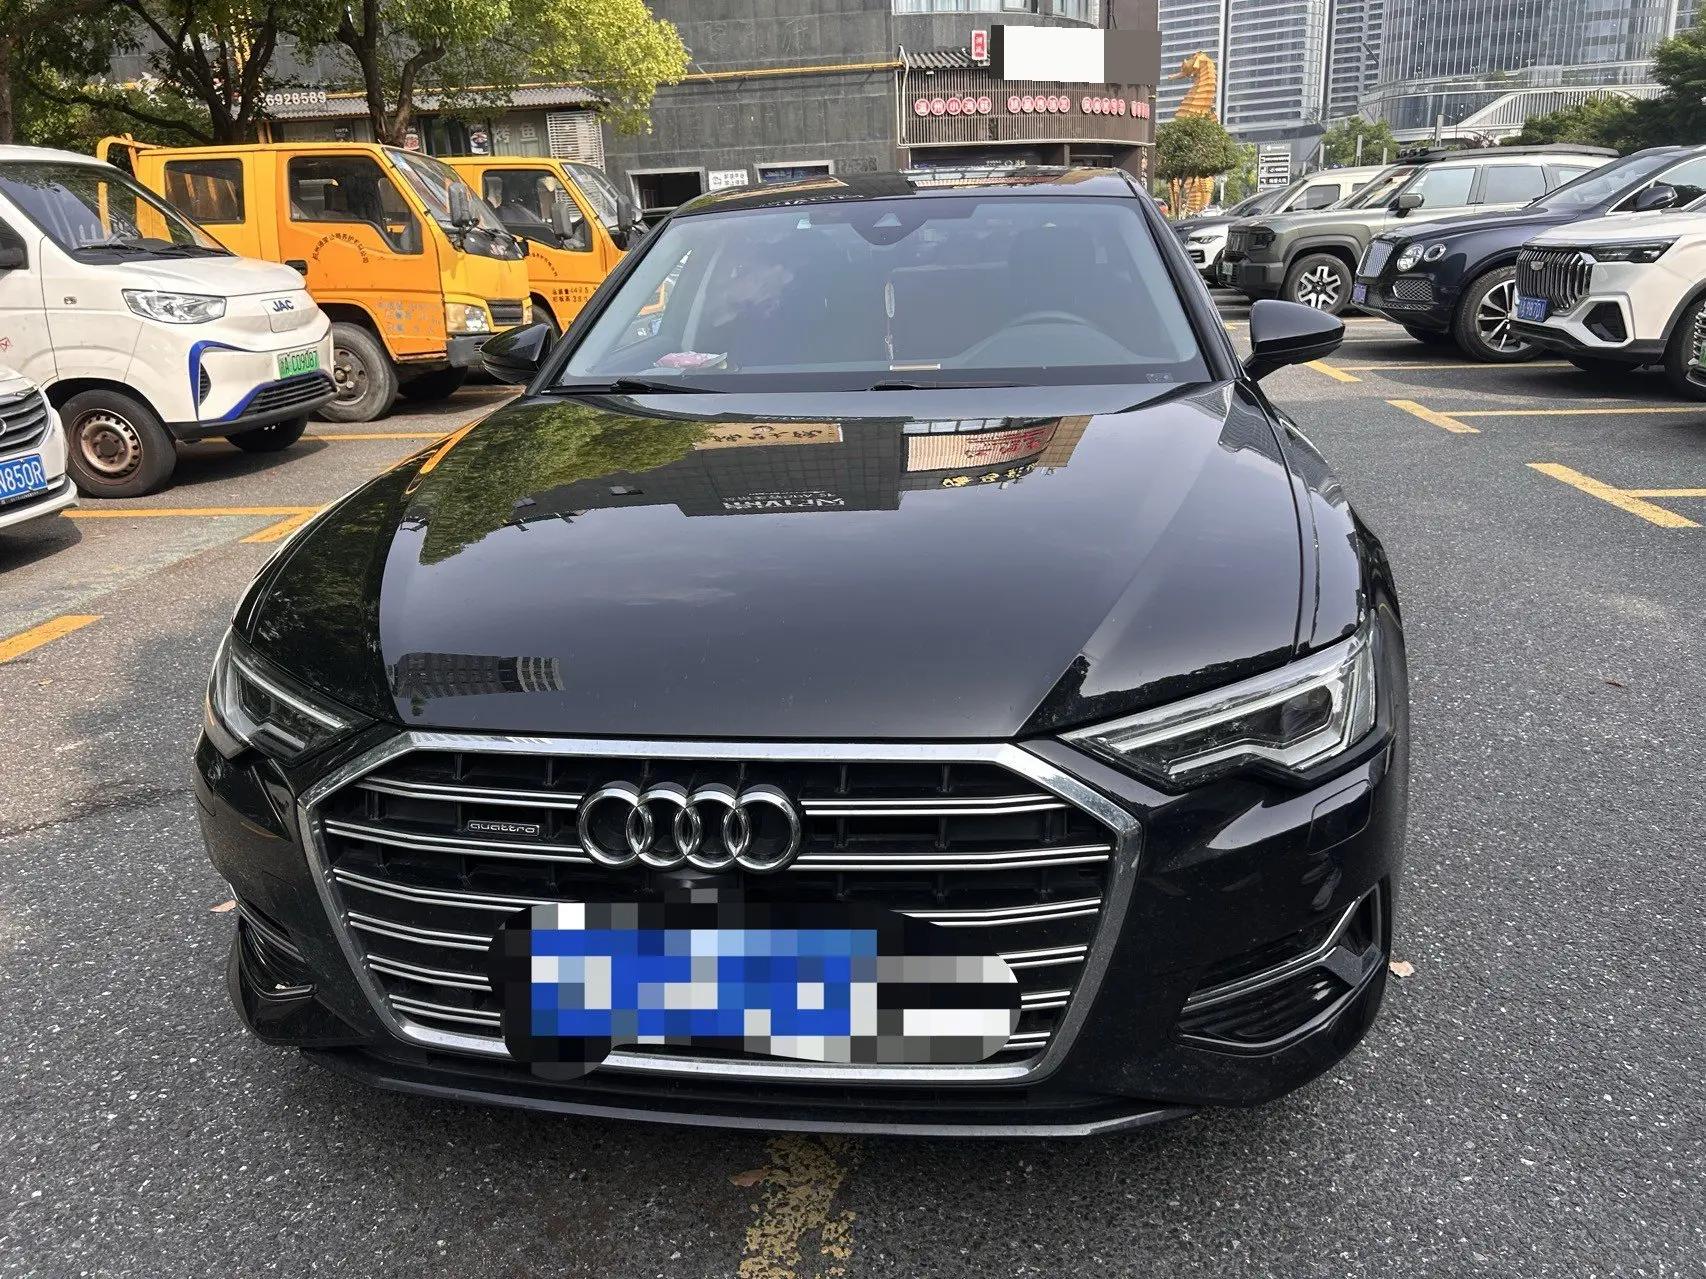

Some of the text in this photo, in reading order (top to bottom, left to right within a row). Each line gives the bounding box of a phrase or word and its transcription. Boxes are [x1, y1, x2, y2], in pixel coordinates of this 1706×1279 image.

[265, 91, 327, 106] 6928589
[273, 300, 294, 312] JAC
[470, 823, 535, 833] quattro
